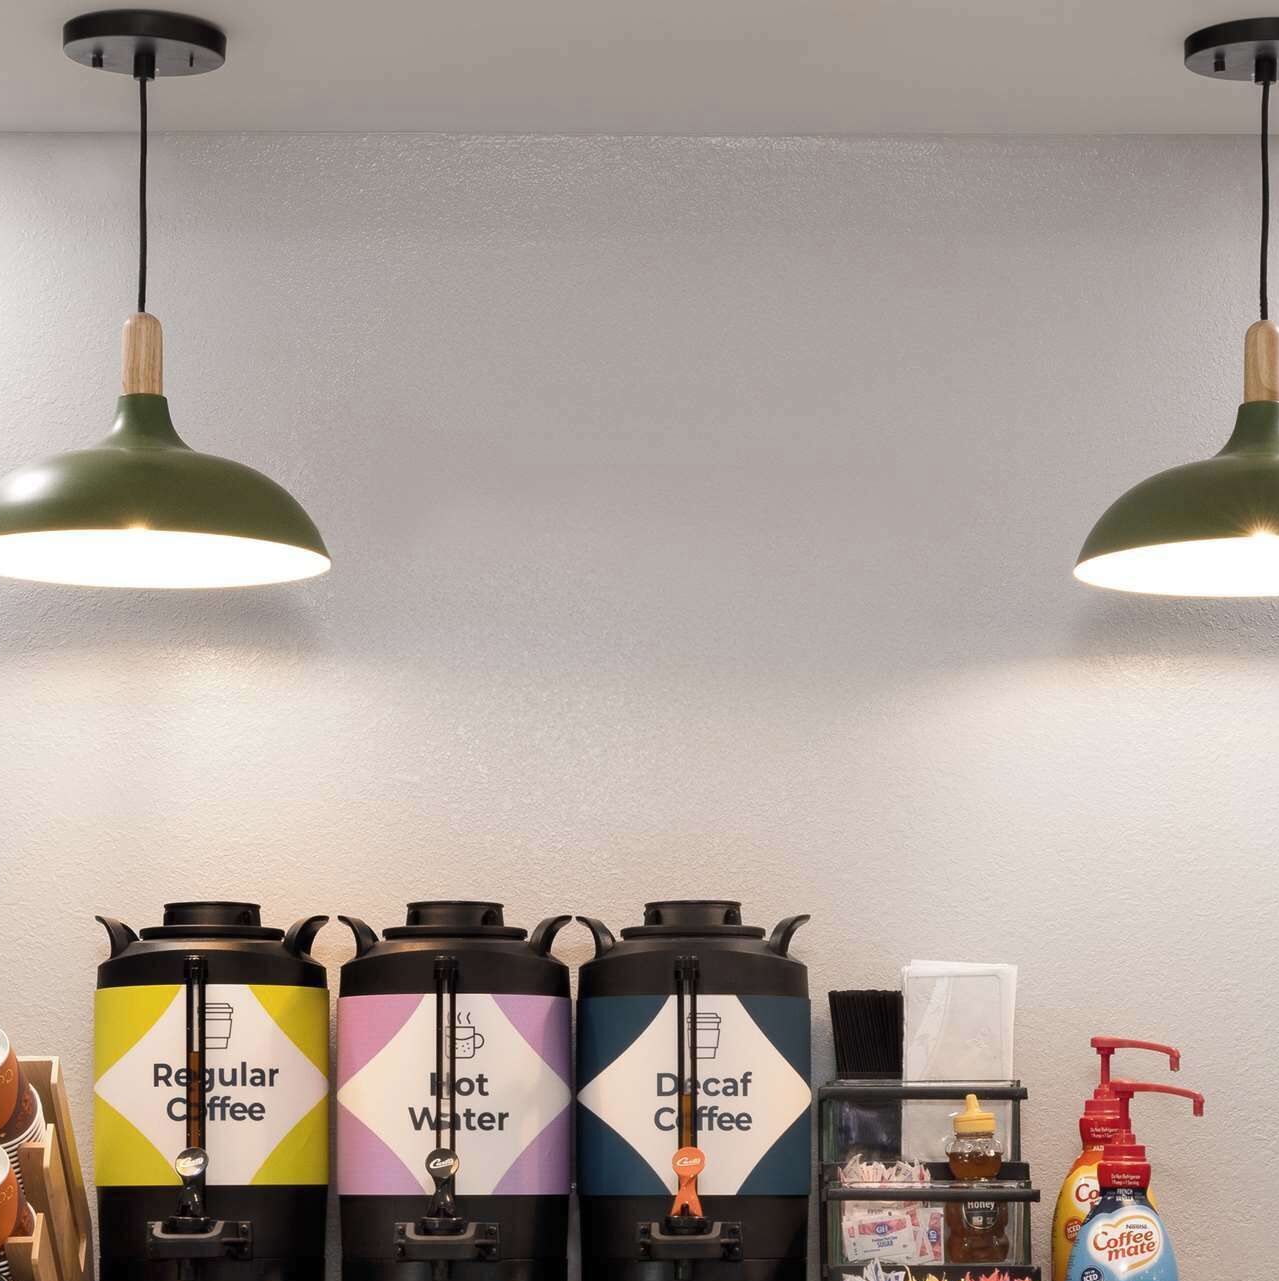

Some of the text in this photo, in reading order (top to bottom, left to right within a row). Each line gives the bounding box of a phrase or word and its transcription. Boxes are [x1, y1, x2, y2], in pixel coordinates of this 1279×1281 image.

[430, 1072, 489, 1096] Hot
[166, 1096, 266, 1121] Cffee
[654, 1105, 752, 1131] Cffee
[967, 1200, 995, 1210] Honey
[1093, 1231, 1154, 1251] Coffee
[1108, 1241, 1156, 1261] mate
[1083, 1273, 1098, 1281] ICED
